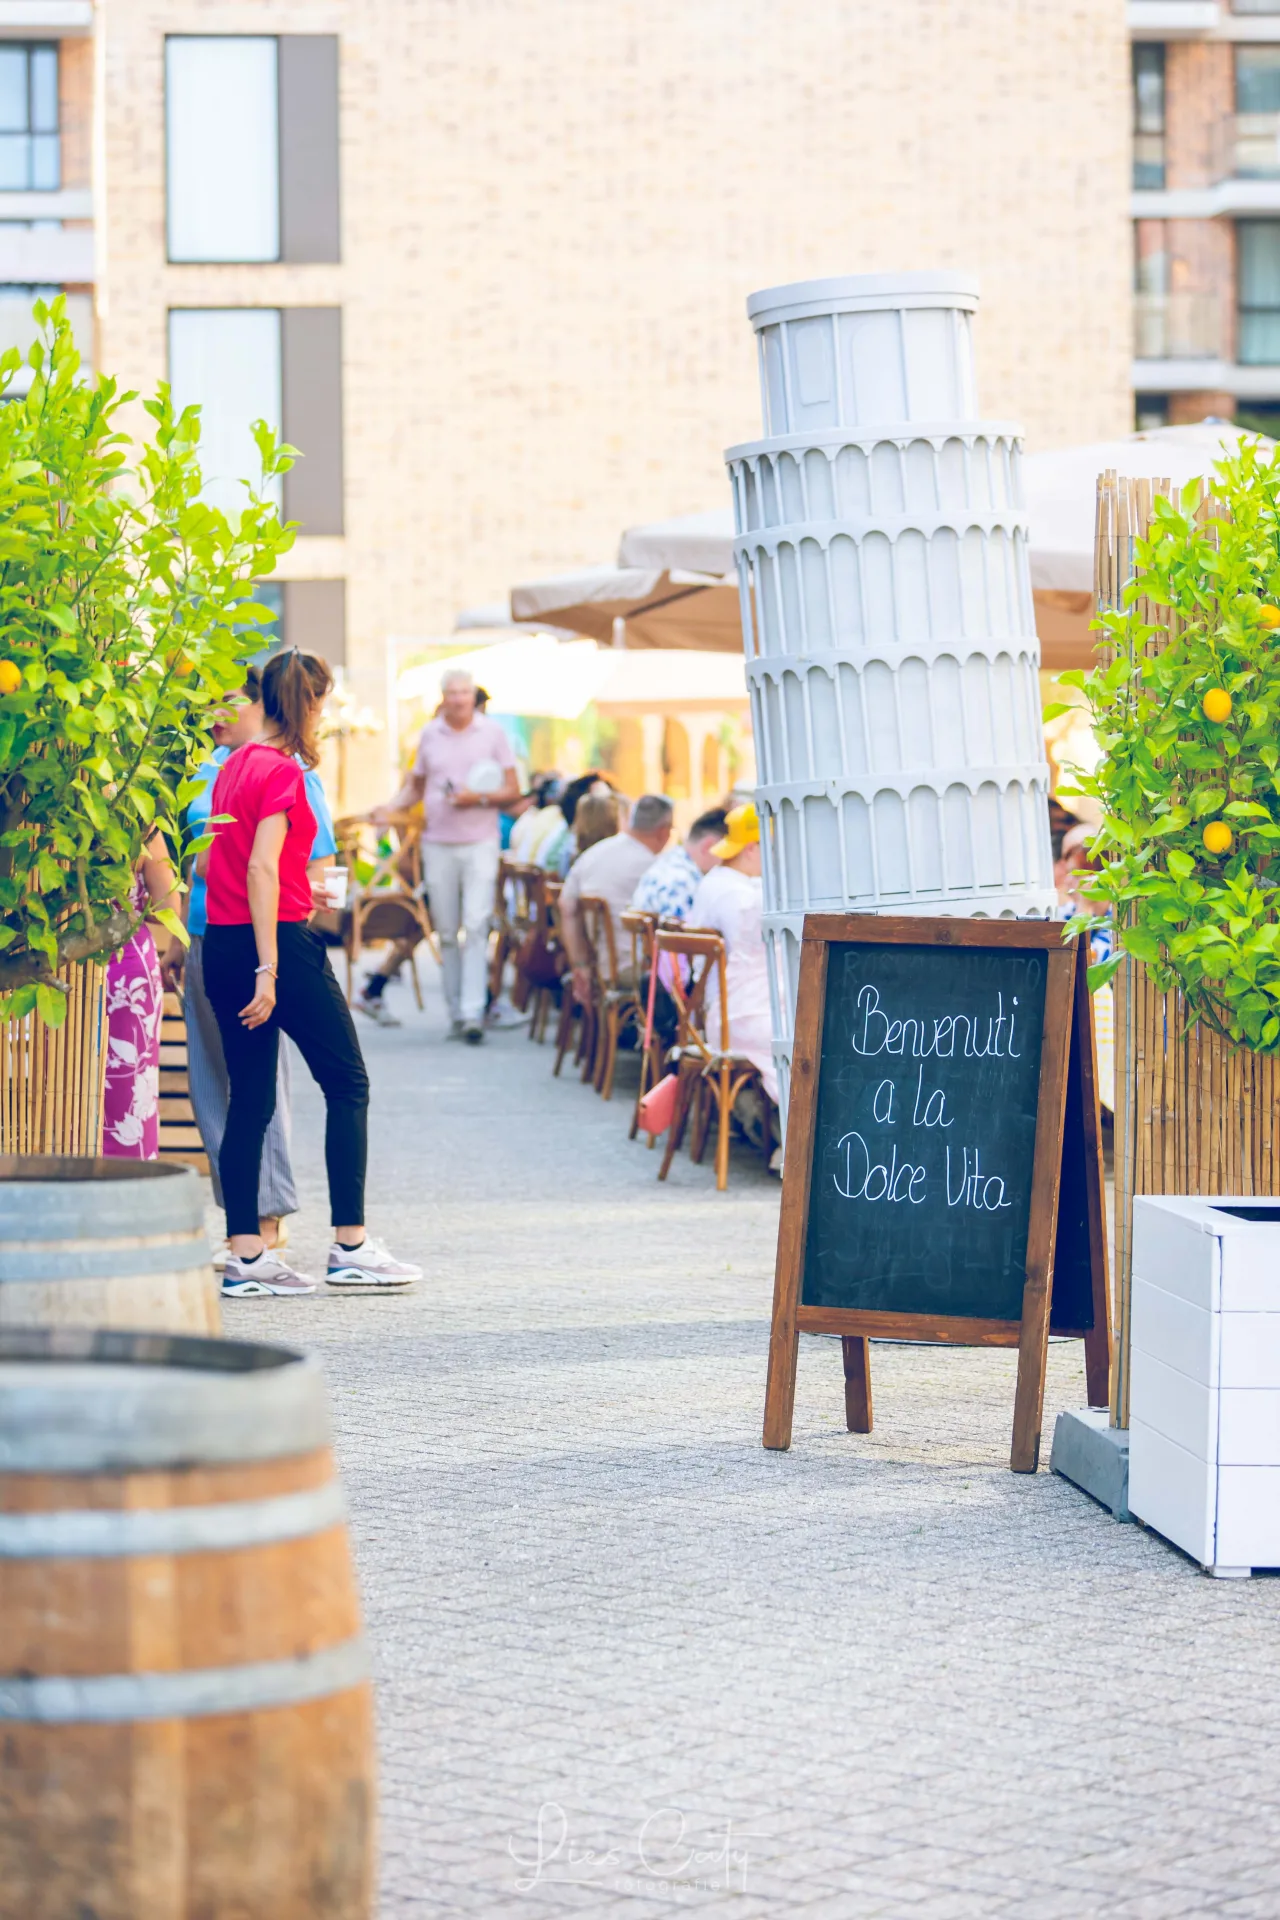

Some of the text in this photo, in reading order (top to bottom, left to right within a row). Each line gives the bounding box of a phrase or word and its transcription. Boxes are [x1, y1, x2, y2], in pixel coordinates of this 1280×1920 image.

[852, 984, 1021, 1058] Benvenuti
[873, 1079, 896, 1124] a
[913, 1063, 955, 1127] la
[833, 1131, 1012, 1211] Dolce Vita
